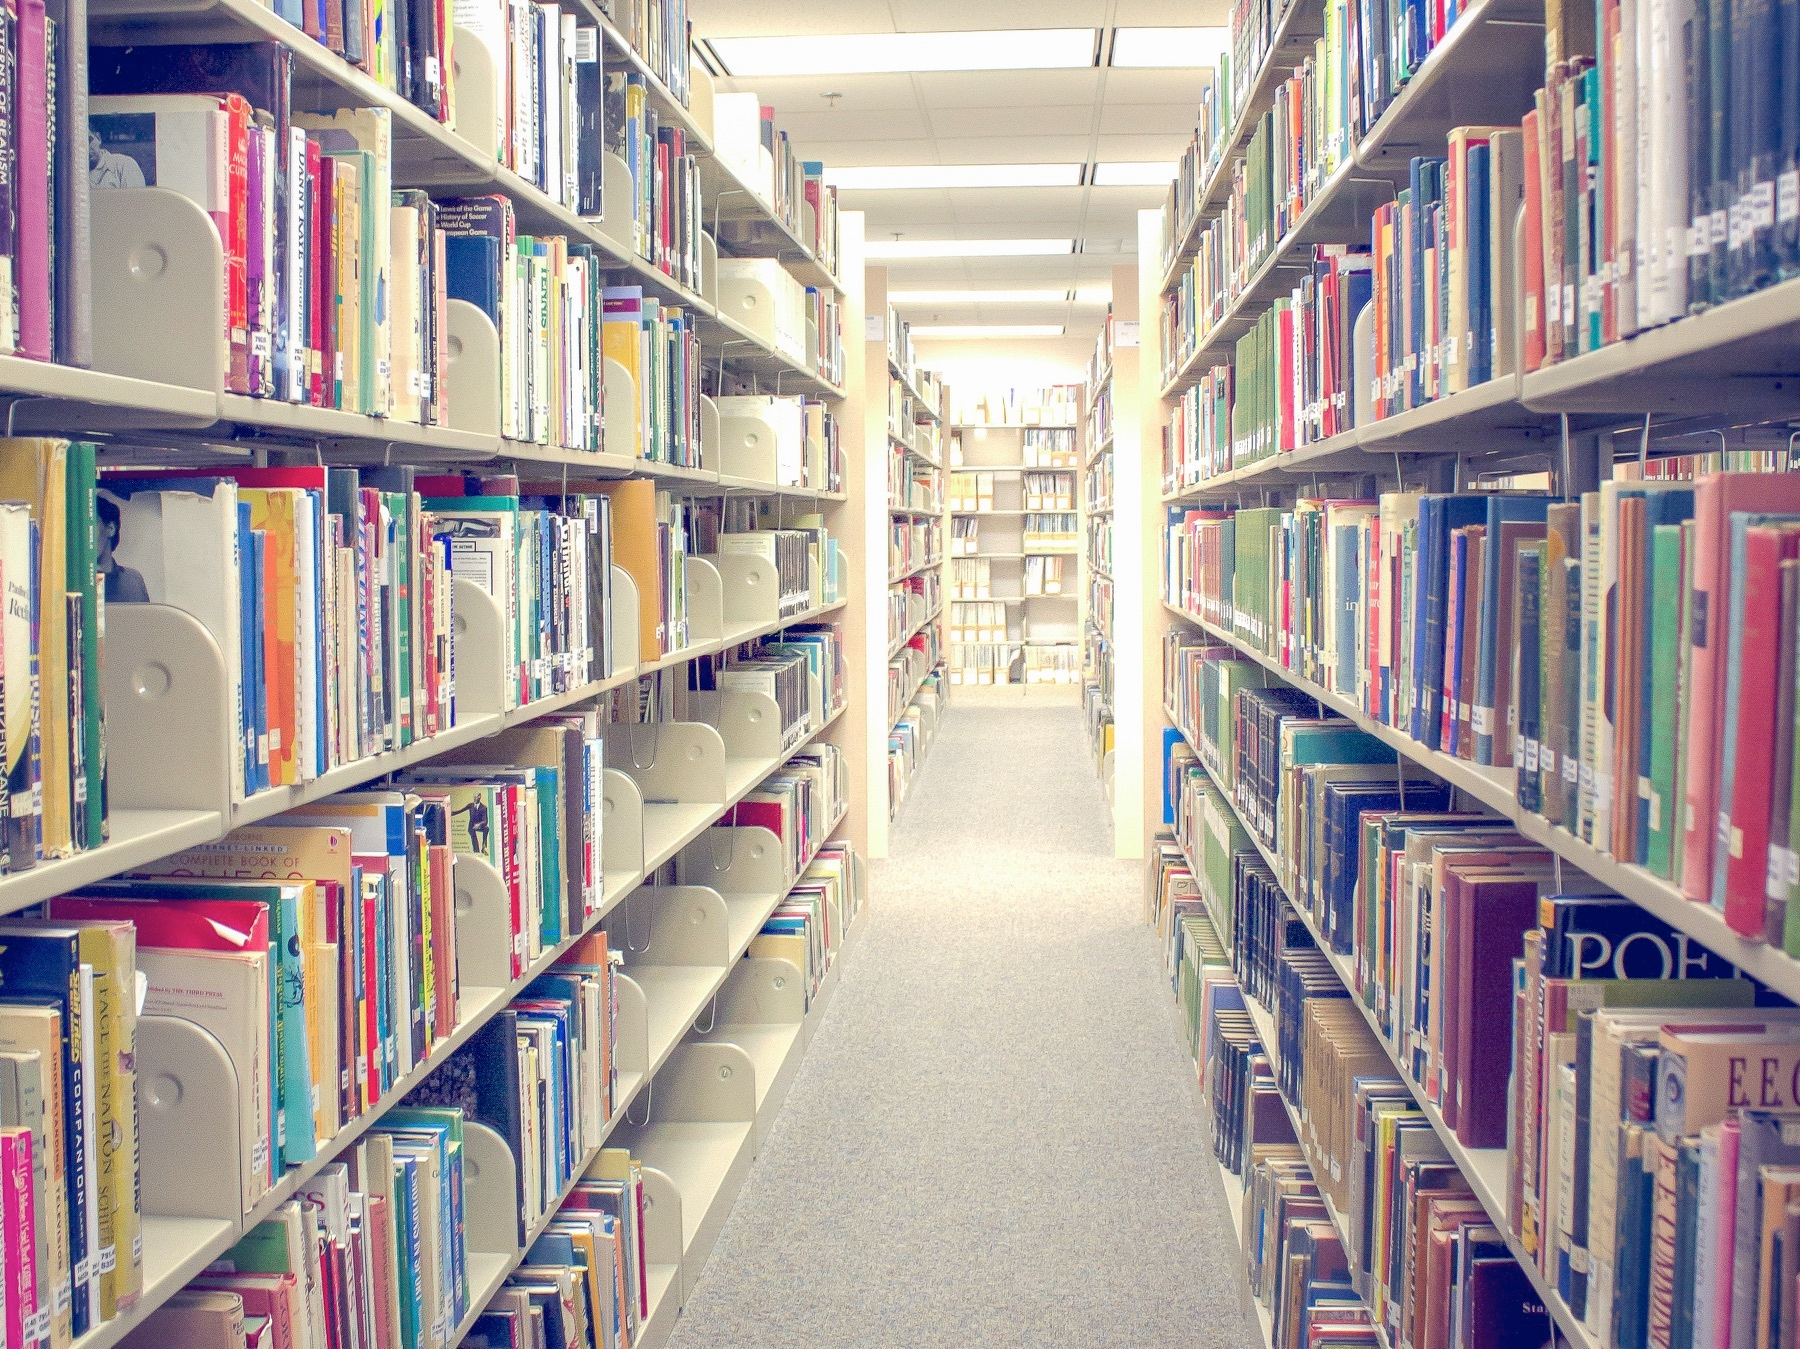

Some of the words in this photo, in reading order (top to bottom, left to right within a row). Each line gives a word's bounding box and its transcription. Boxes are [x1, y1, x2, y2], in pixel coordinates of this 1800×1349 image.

[441, 213, 461, 221] History
[461, 212, 468, 220] of
[469, 212, 488, 220] Soccer
[459, 221, 472, 229] Cup
[473, 204, 493, 212] Game
[540, 267, 548, 328] TENNIS
[0, 764, 9, 818] KANE
[170, 855, 234, 866] COMPLETE
[241, 856, 277, 867] BOOK
[284, 857, 300, 868] OF
[1564, 931, 1708, 980] POE
[52, 1051, 60, 1174] UNDERSTANDING
[73, 1069, 84, 1206] COMPANION
[101, 1083, 112, 1175] NATION
[55, 1185, 63, 1271] TELEVISION
[411, 1169, 420, 1239] EMOTIONS
[413, 1240, 422, 1257] IN
[414, 1258, 423, 1303] SPORT
